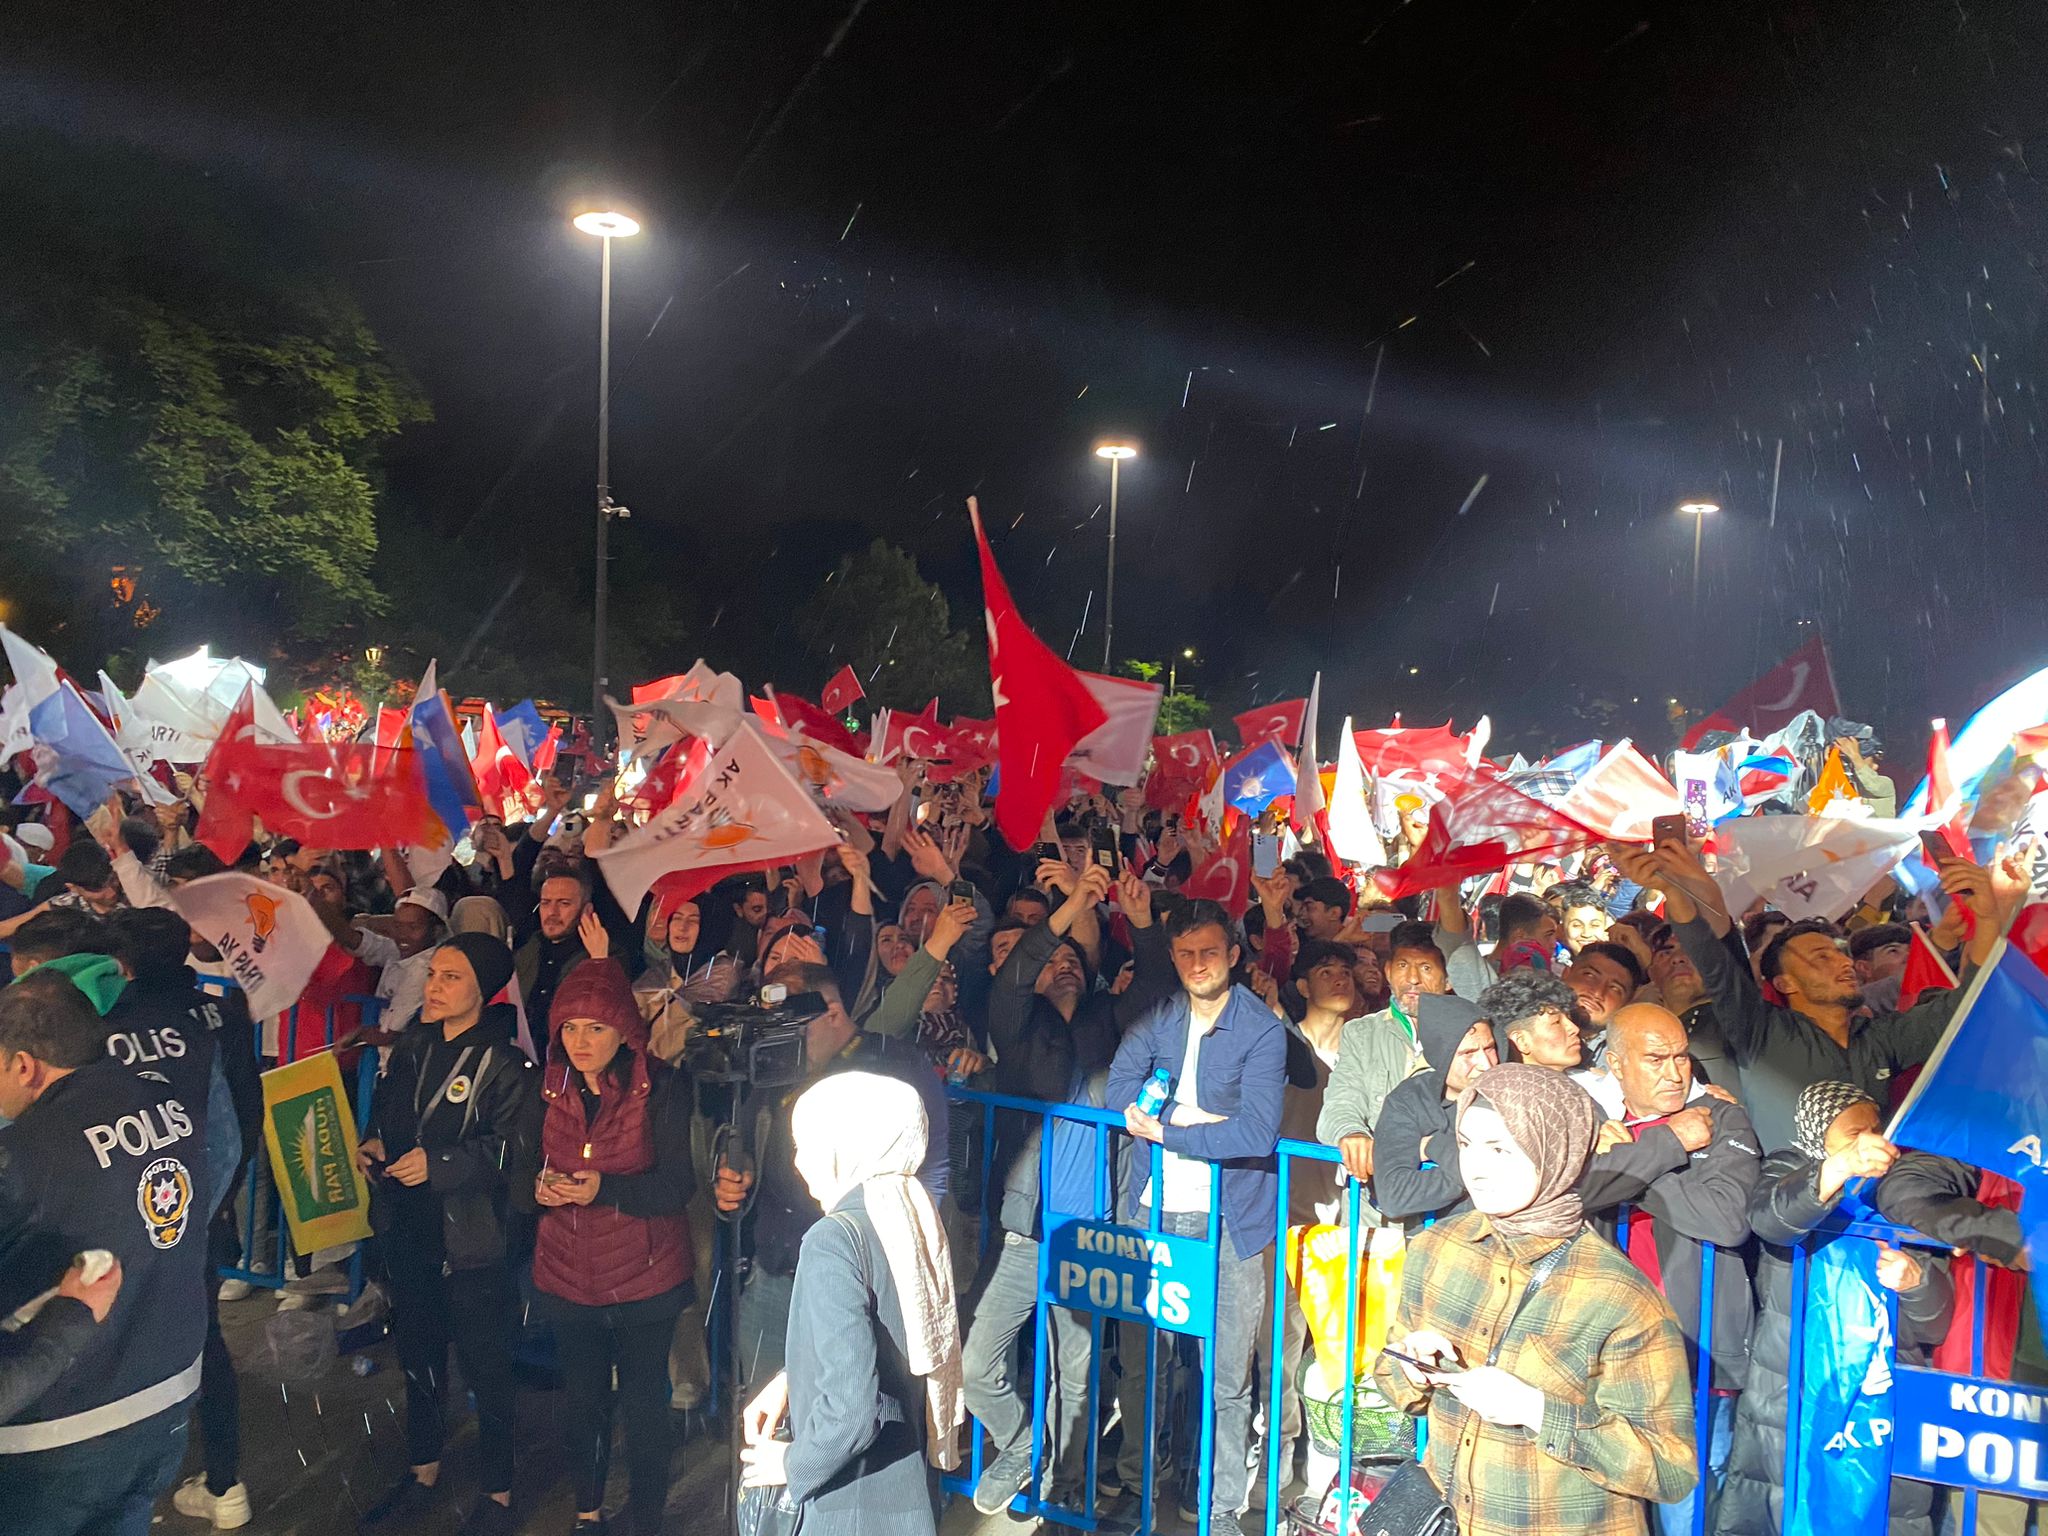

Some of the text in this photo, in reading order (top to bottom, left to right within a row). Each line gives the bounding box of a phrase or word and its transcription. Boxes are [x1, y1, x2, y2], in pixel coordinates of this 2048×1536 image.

[716, 758, 741, 789] AK
[217, 932, 241, 960] AK
[1076, 1226, 1173, 1268] KONYA
[1058, 1260, 1191, 1325] POLİS
[1950, 1382, 2048, 1424] KON
[1823, 1420, 1863, 1452] AK
